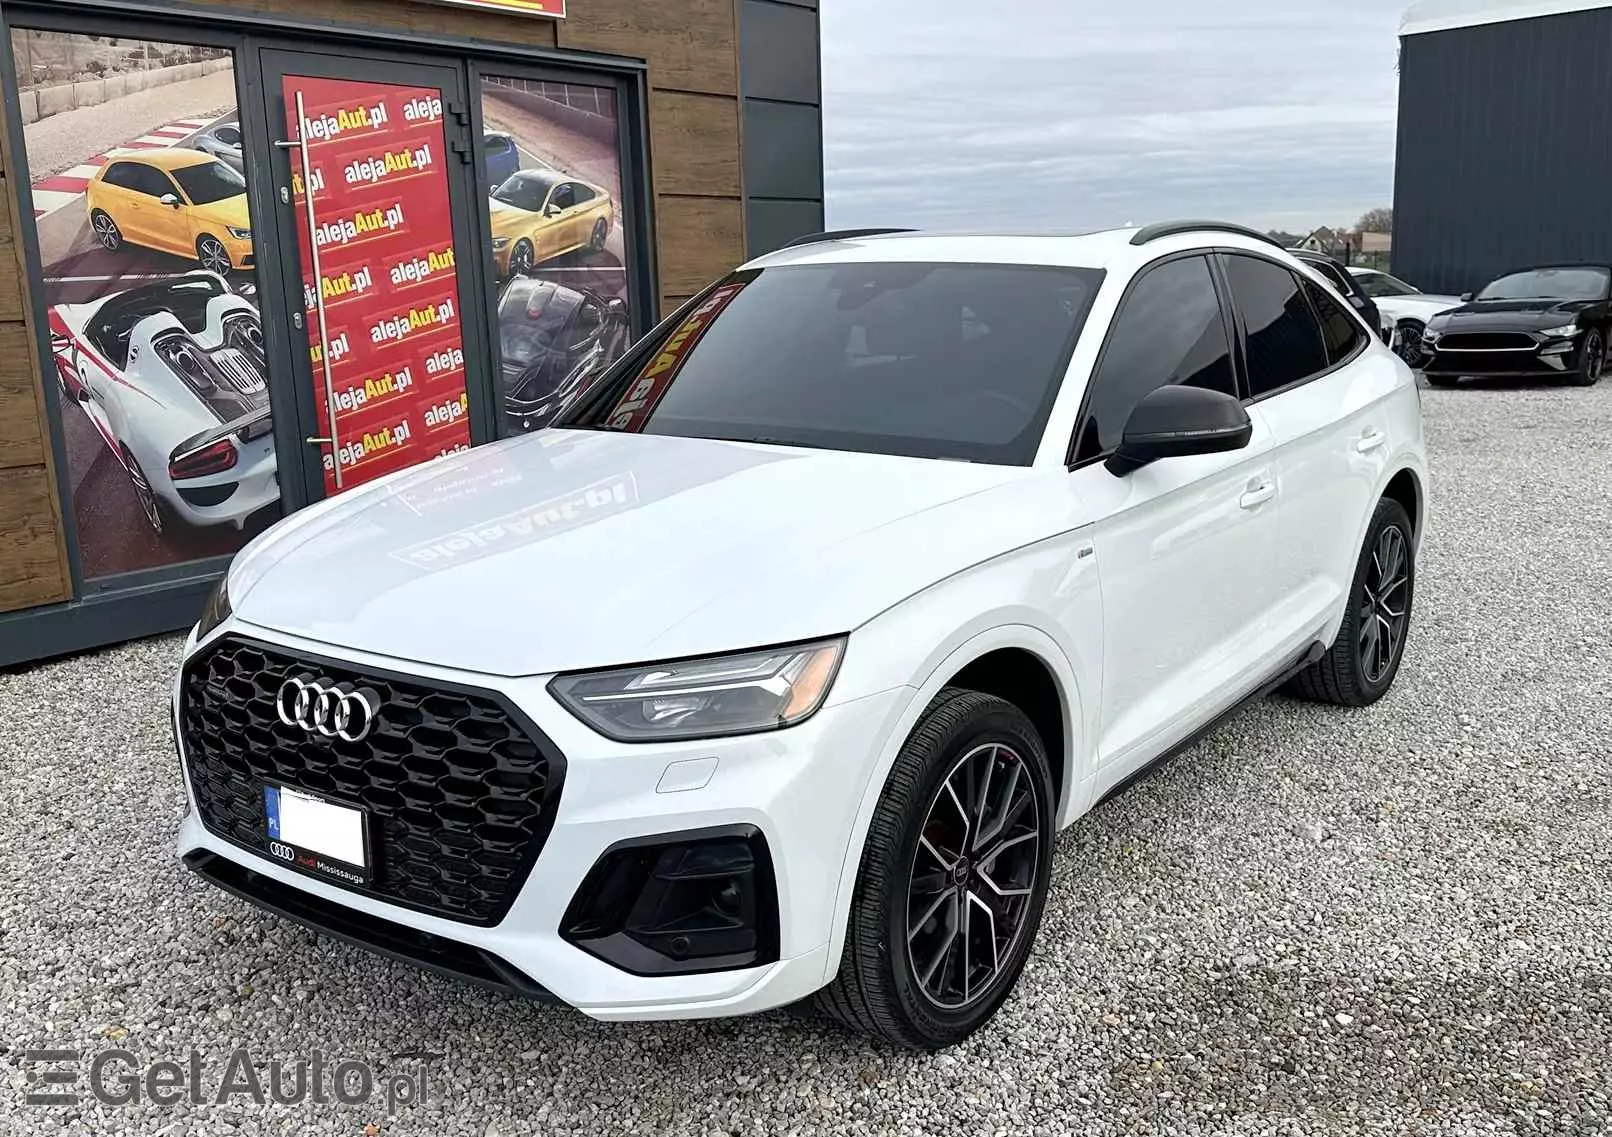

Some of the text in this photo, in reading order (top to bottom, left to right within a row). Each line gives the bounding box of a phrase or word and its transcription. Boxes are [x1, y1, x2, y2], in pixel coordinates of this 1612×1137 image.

[296, 102, 388, 140] lejaAut.pl
[344, 144, 433, 183] alejaAut.pl
[316, 203, 404, 246] alejaAut.pl
[390, 247, 455, 284] alejaAut
[370, 299, 455, 343] alejaAut.pl
[426, 348, 464, 374] aleja
[325, 366, 413, 414] lejaAut.pl
[323, 420, 411, 470] aejaAut.pl
[268, 817, 279, 831] PL
